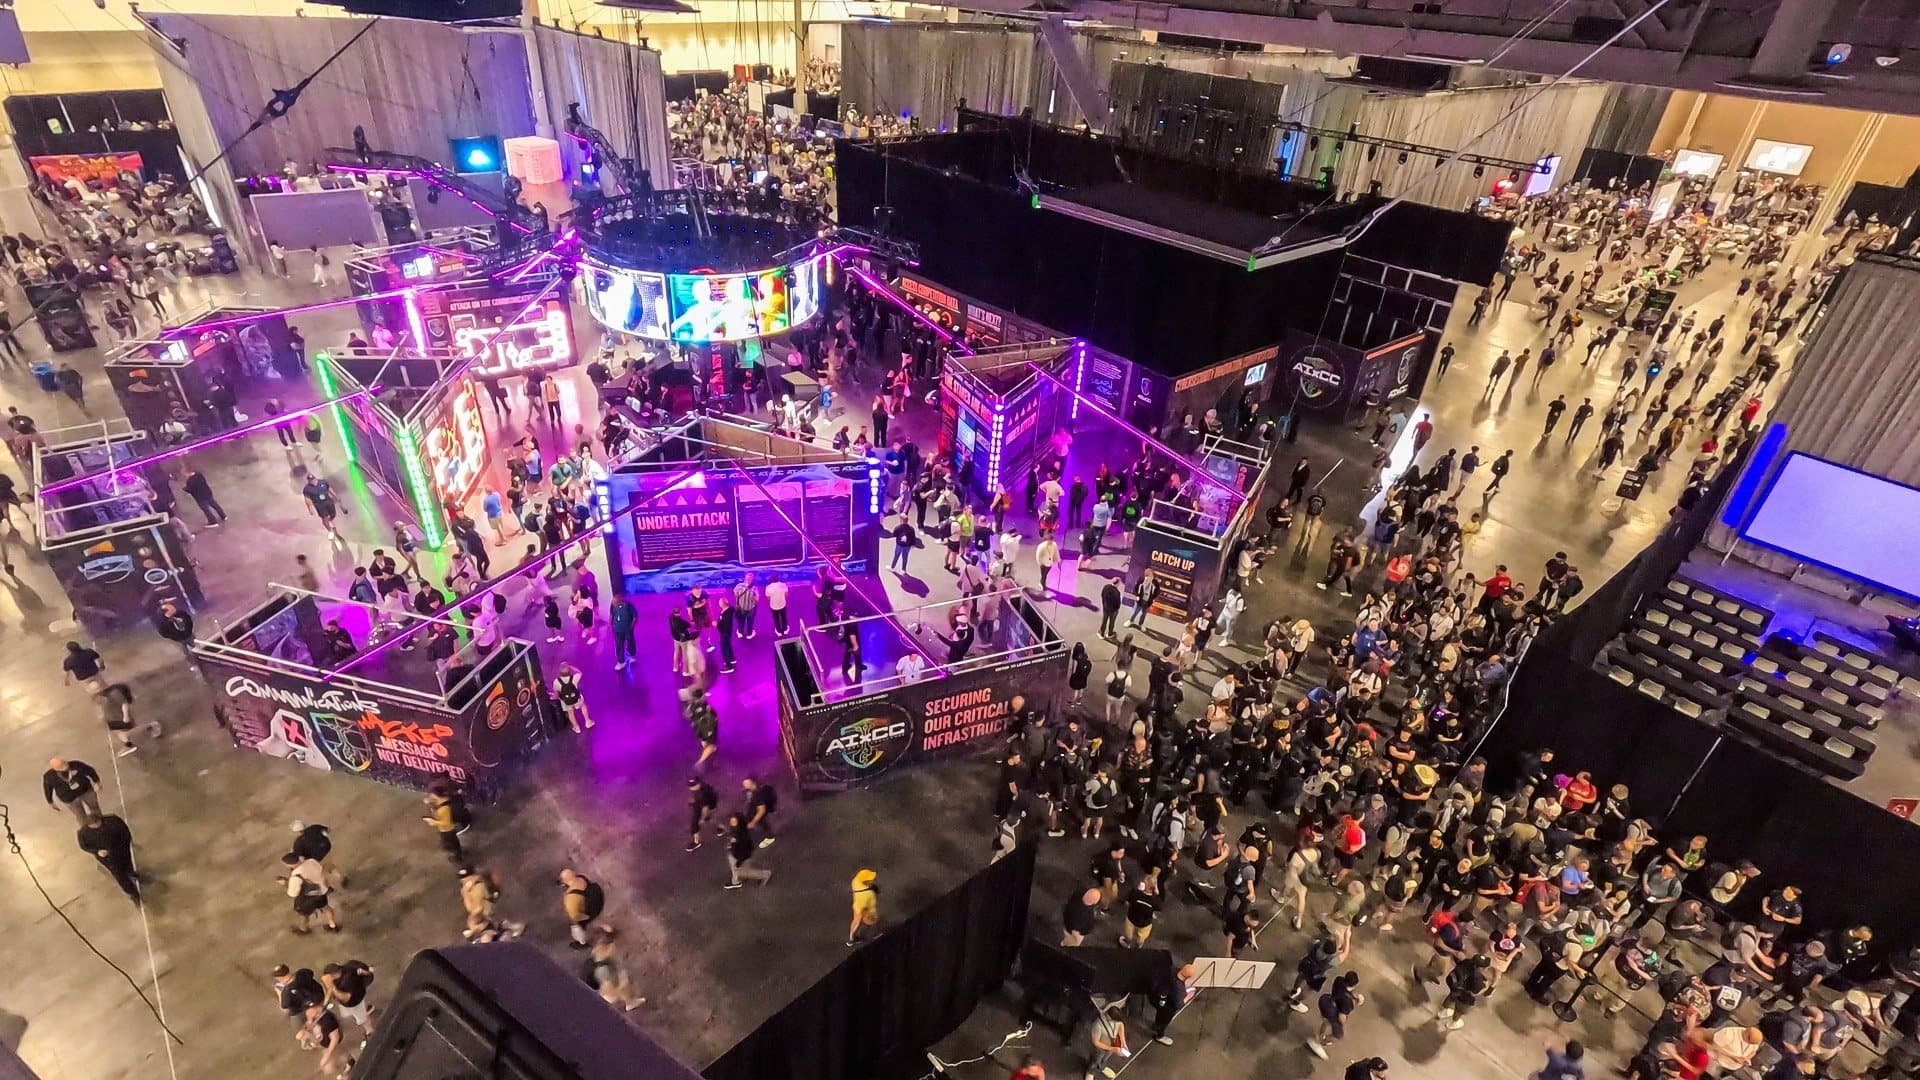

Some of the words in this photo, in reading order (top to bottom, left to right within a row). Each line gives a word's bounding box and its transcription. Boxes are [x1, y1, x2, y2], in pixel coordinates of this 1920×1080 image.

[451, 302, 471, 311] ATTACK
[636, 515, 679, 531] UNDER
[681, 511, 730, 528] ATTACK!
[1151, 550, 1180, 568] CATCH
[1181, 559, 1195, 571] UP
[925, 688, 991, 716] SECURING
[924, 714, 951, 733] OUR
[954, 701, 1009, 725] CRITICAL
[825, 722, 906, 753] AIxCC
[923, 718, 1009, 751] INFRASTRUCT
[376, 747, 401, 765] NOT
[380, 735, 438, 760] MESSAGE
